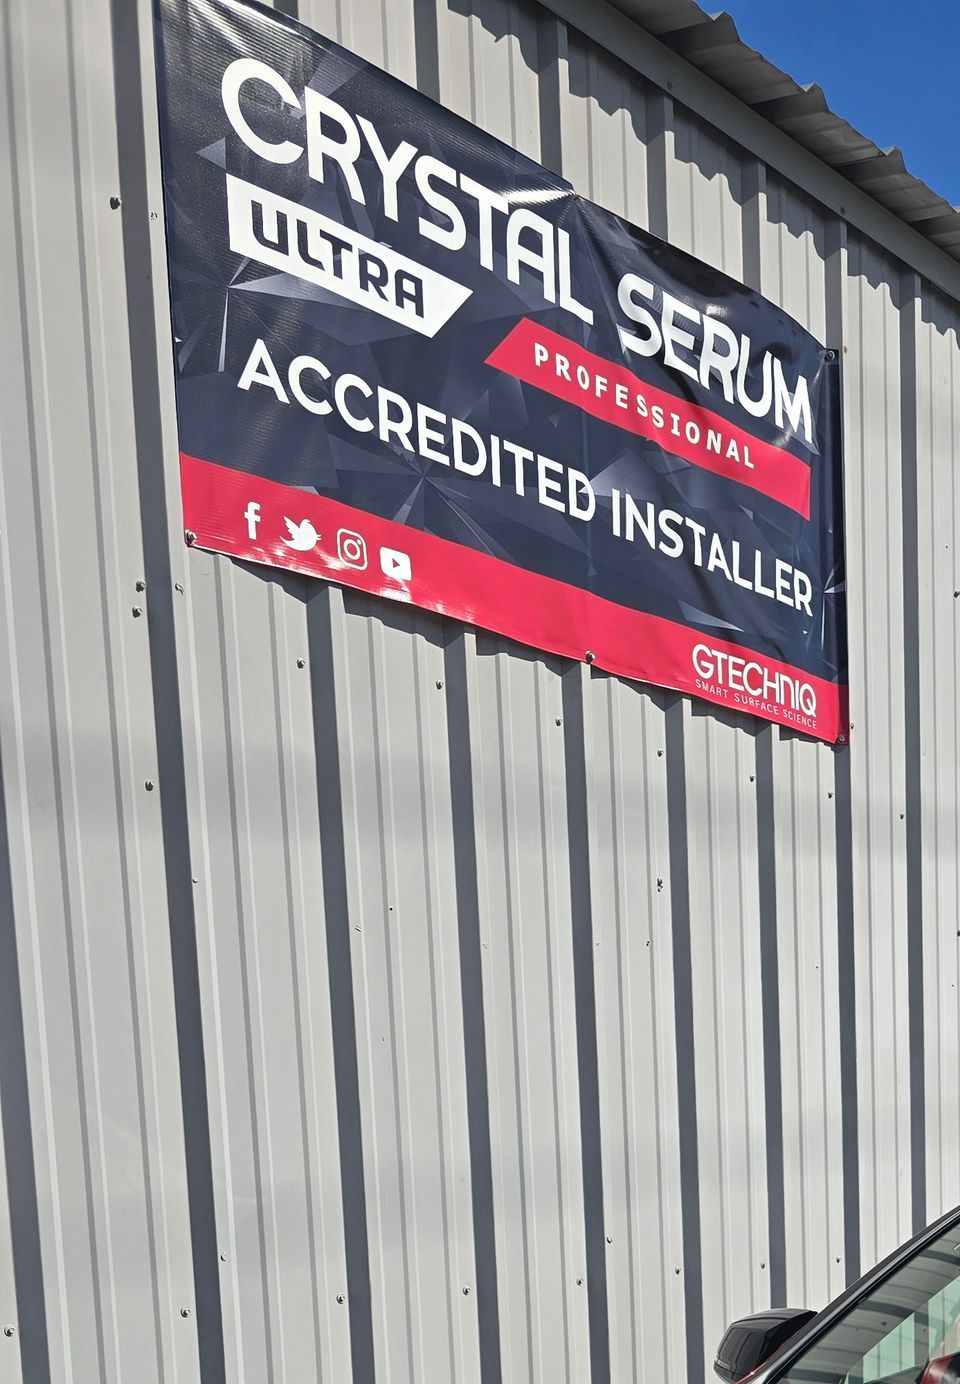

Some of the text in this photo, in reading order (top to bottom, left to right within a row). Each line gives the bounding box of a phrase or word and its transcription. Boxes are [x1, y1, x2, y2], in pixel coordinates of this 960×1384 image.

[222, 57, 814, 445] CRYSTAL SERUM
[250, 199, 426, 319] ULTRA
[534, 342, 756, 470] PROFESSIONAL
[236, 339, 814, 617] ACCREDITED INSTALLER
[692, 643, 817, 718] GTECHNIQ
[695, 678, 817, 730] SMART SURFACE SCIENCE
